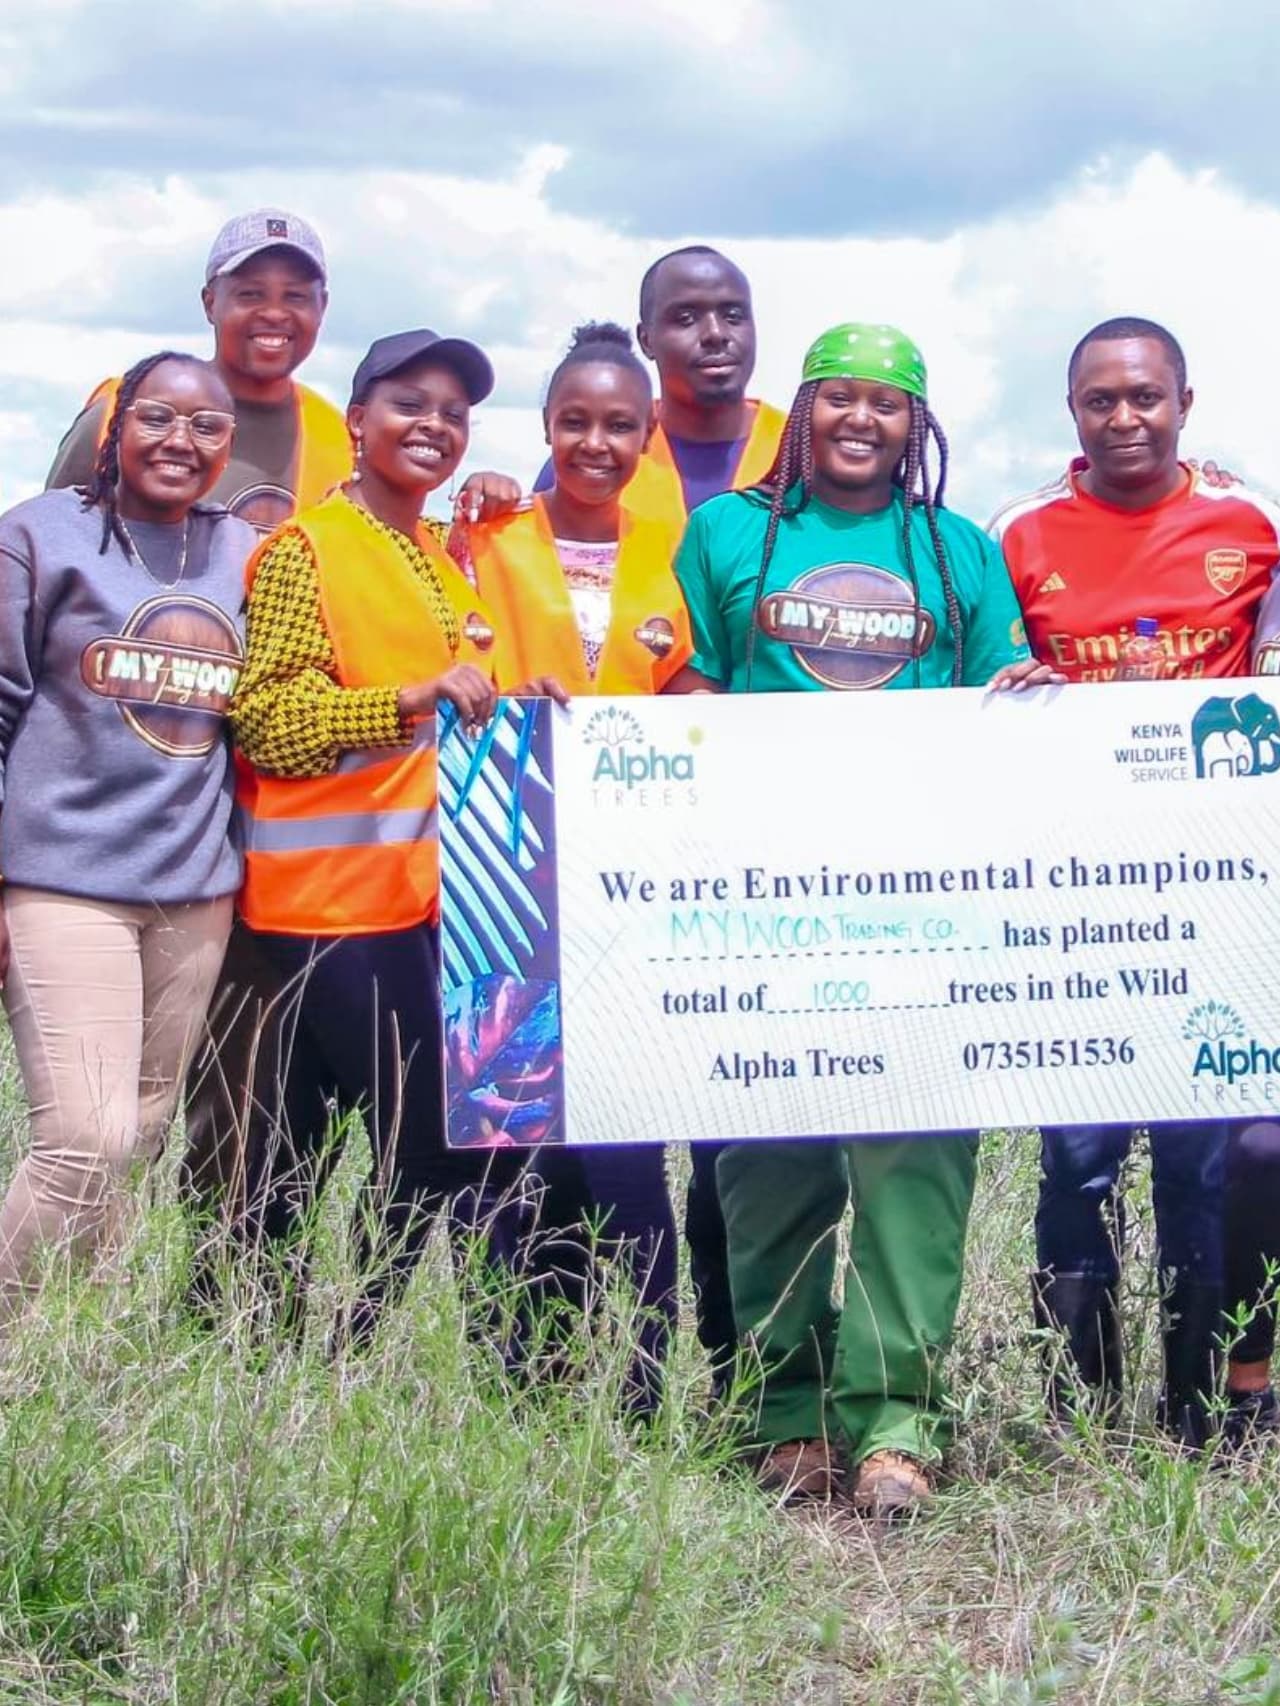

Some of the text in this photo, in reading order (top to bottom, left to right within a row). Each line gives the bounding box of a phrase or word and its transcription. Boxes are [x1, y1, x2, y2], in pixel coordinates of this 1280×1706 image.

[780, 600, 916, 638] MY WOOD
[1048, 624, 1232, 667] Emiates
[109, 649, 164, 682] MY
[1131, 724, 1183, 739] KENYA
[592, 746, 694, 789] Alpha
[1115, 747, 1188, 763] WILDLIFE
[1131, 768, 1188, 783] SERVICE
[592, 789, 699, 806] TREES
[599, 852, 1268, 902] We are Environmental champions,
[671, 910, 730, 955] MY
[743, 911, 833, 949] WOOD
[1003, 914, 1197, 952] has planted a
[662, 984, 768, 1015] total of
[813, 980, 870, 1007] 1000
[949, 967, 1189, 1004] trees in the Wild
[709, 1048, 885, 1088] Alpha Trees
[963, 1036, 1135, 1071] 0735151536
